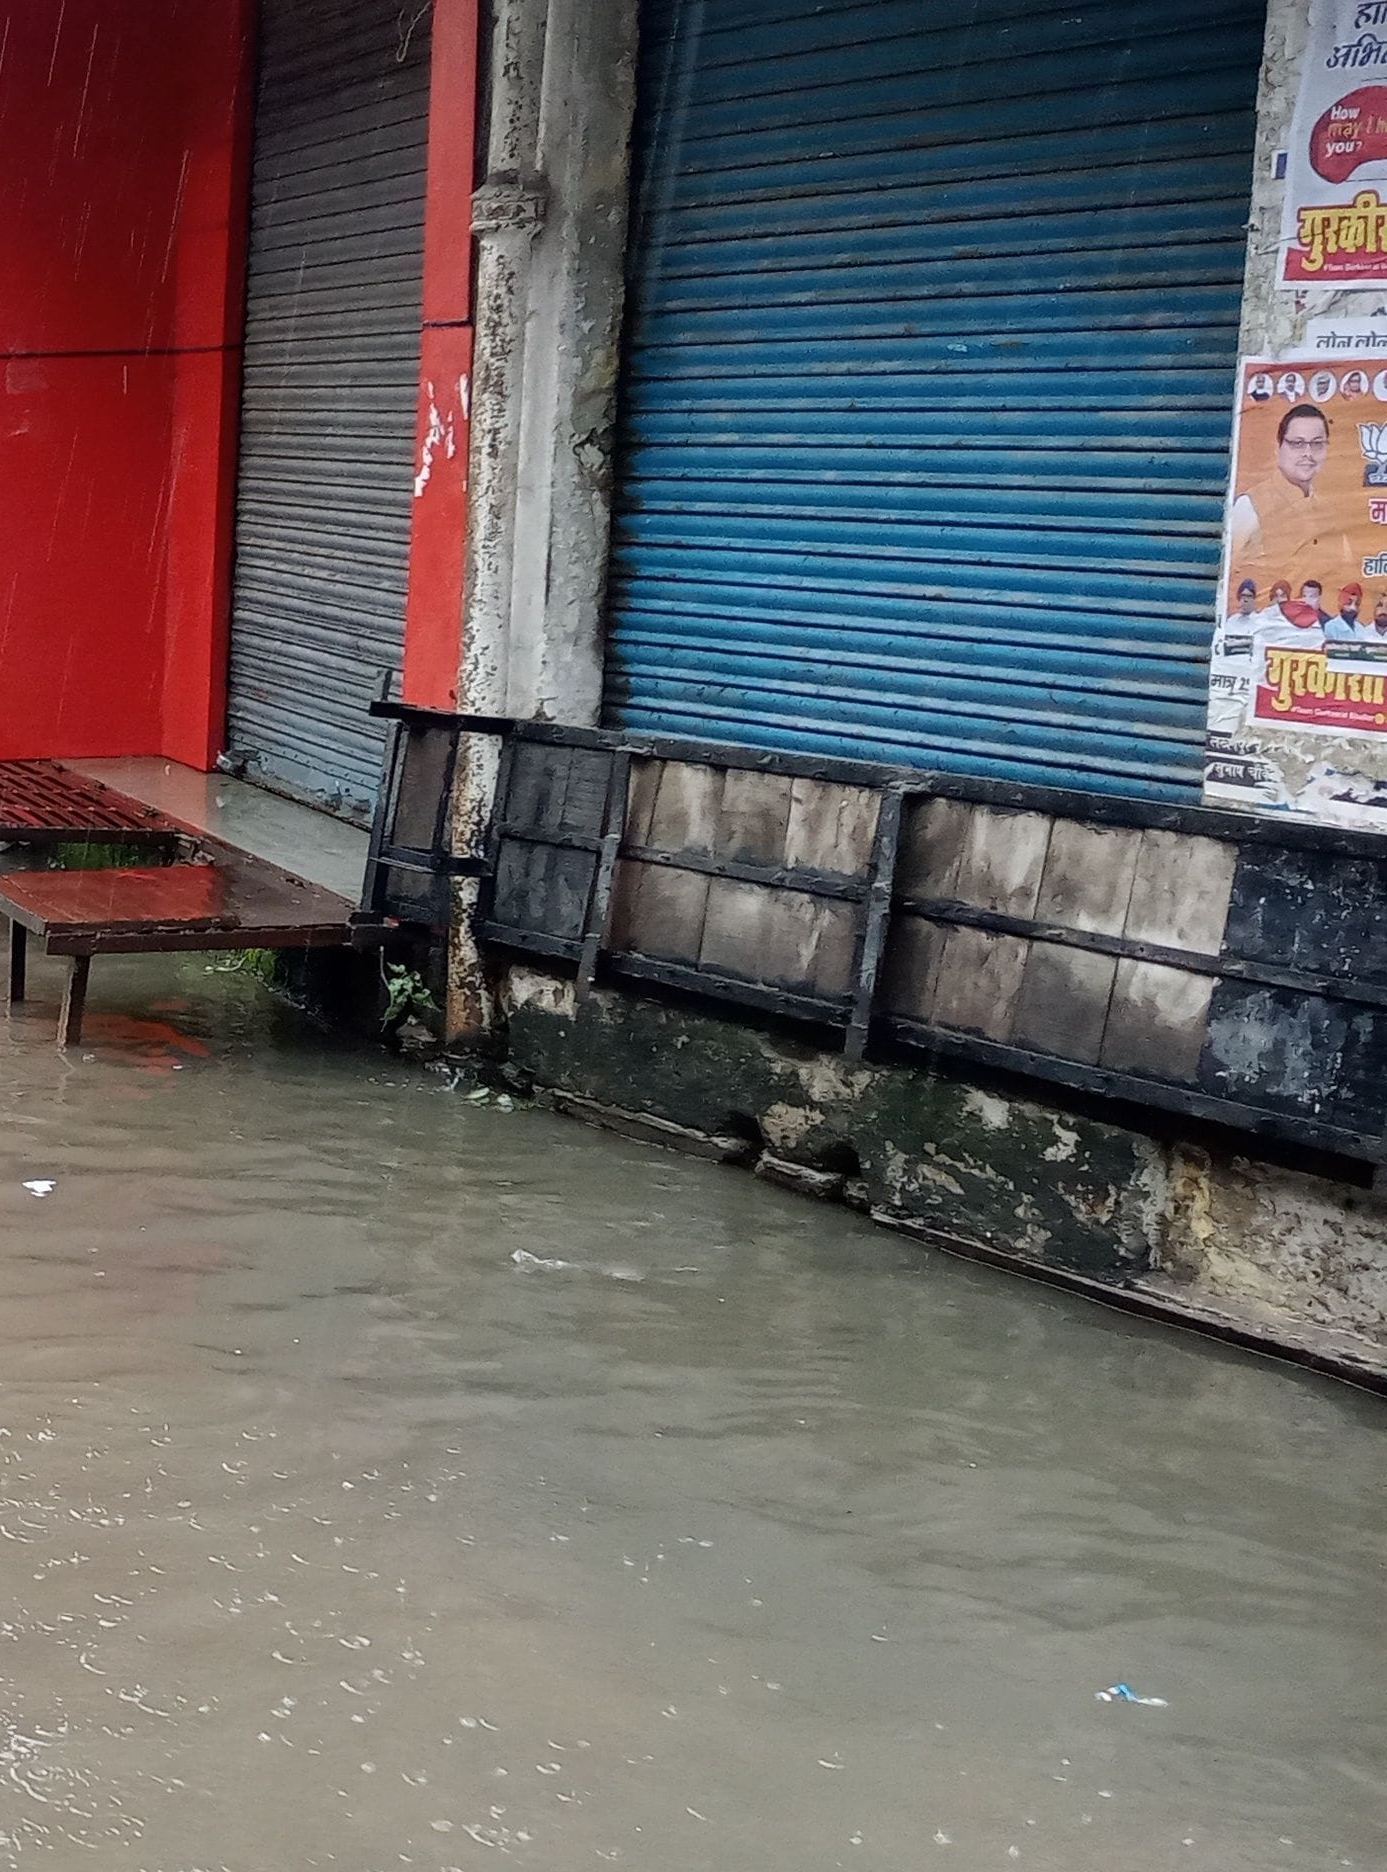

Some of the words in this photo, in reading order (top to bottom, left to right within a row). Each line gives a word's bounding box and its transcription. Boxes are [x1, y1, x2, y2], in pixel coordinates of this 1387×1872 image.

[1330, 106, 1361, 120] How
[1327, 121, 1363, 139] may
[1325, 141, 1363, 157] you?
